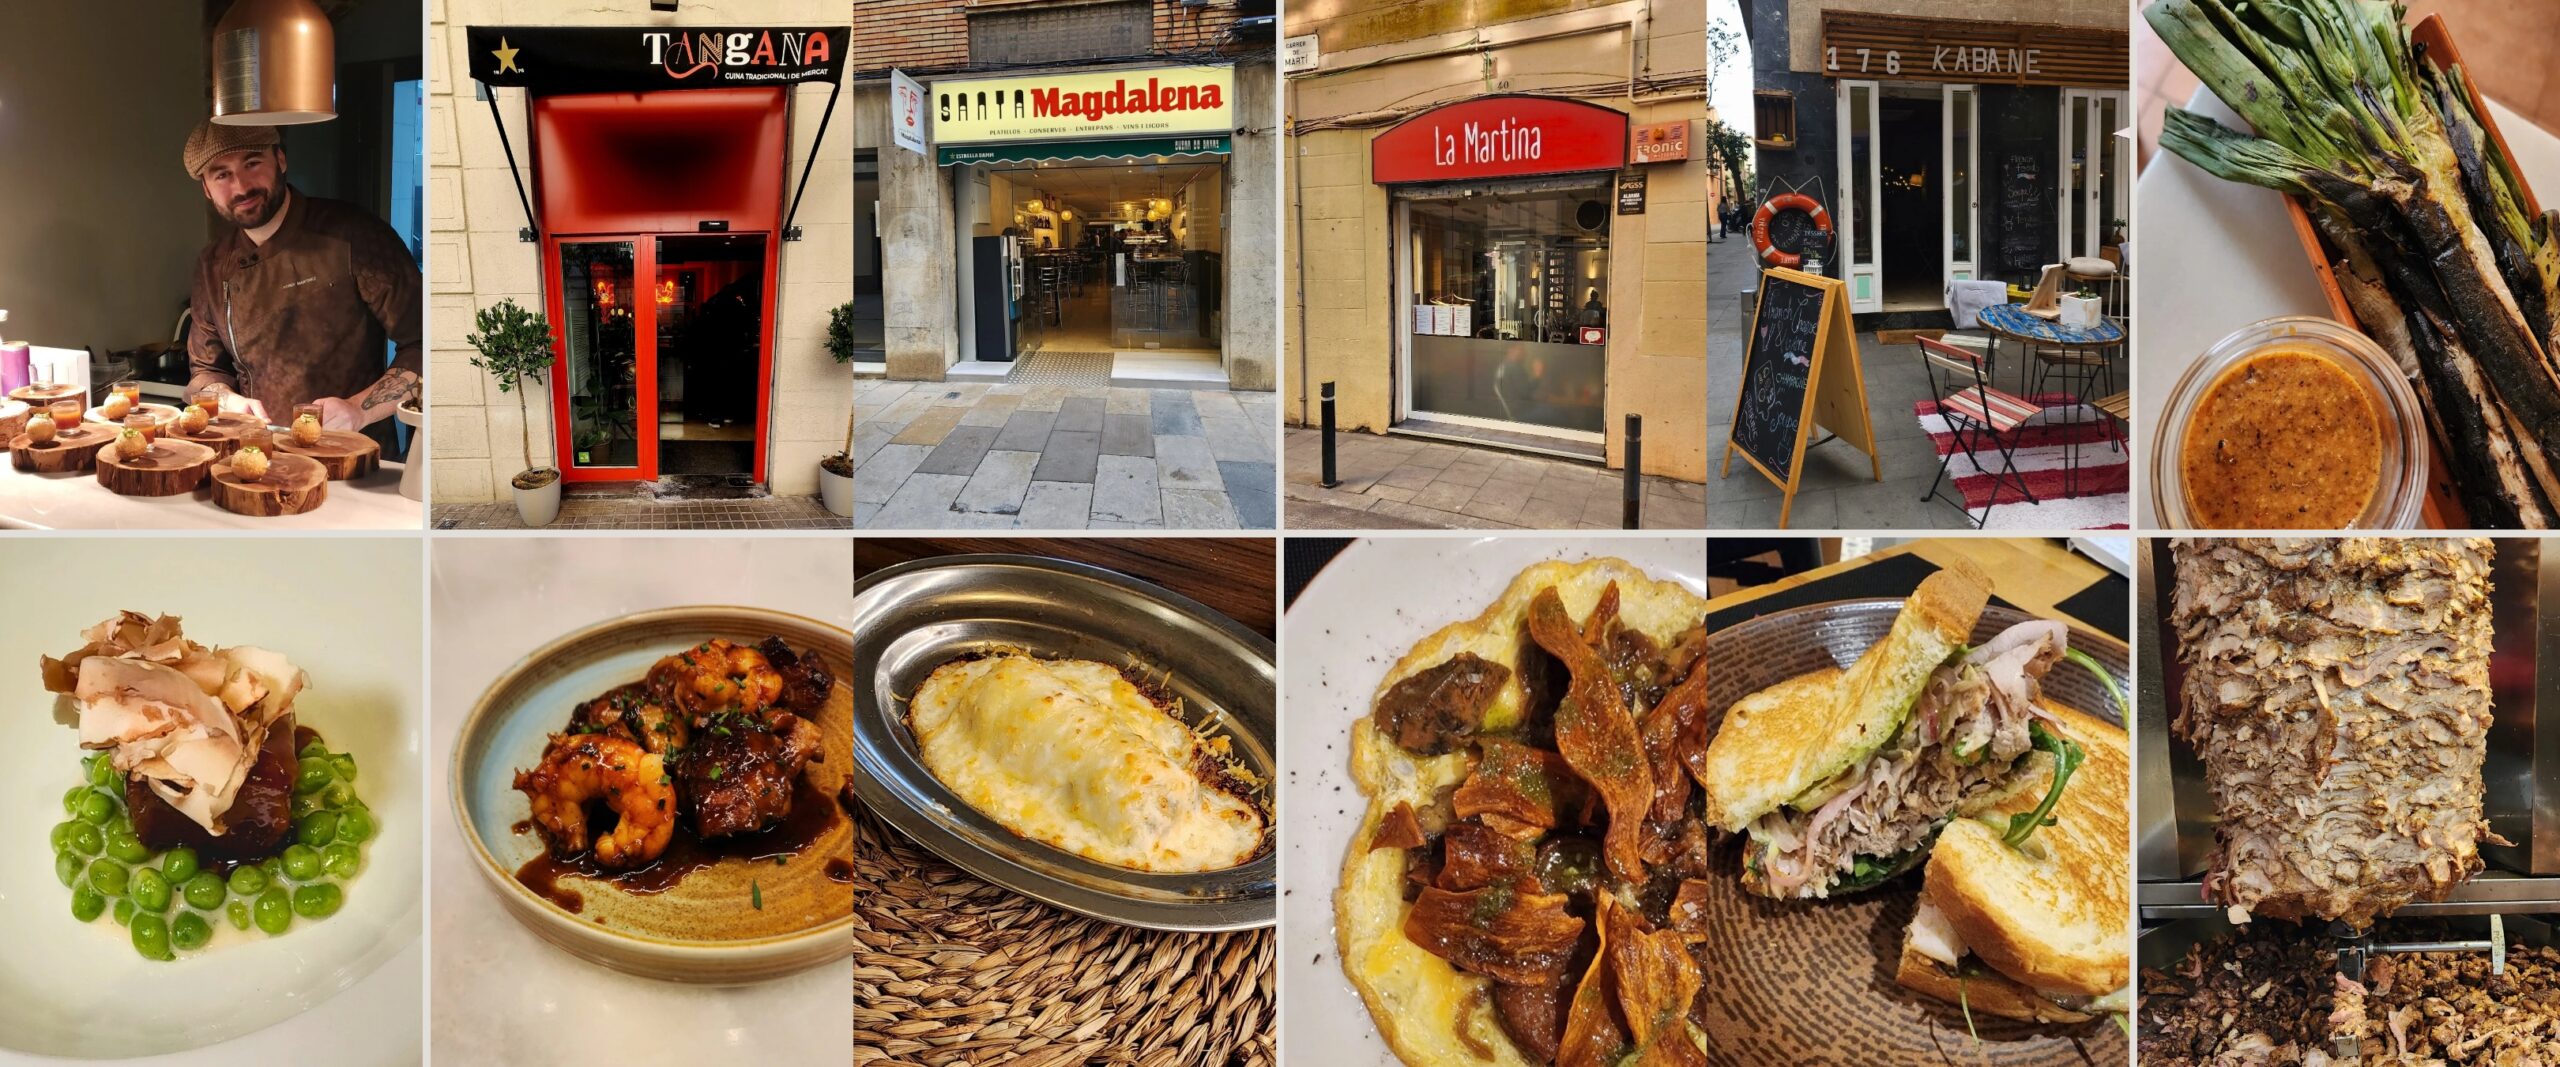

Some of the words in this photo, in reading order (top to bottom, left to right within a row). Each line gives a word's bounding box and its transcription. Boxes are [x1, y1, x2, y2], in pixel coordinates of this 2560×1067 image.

[725, 72, 745, 80] CUINA
[745, 72, 787, 80] TRADICIONAL
[801, 68, 829, 77] MERCAT
[1932, 45, 2041, 74] KABANE
[1497, 80, 1510, 89] 40
[1030, 77, 1224, 122] Magdalena
[1435, 125, 1456, 166] La
[1464, 116, 1541, 164] Martina
